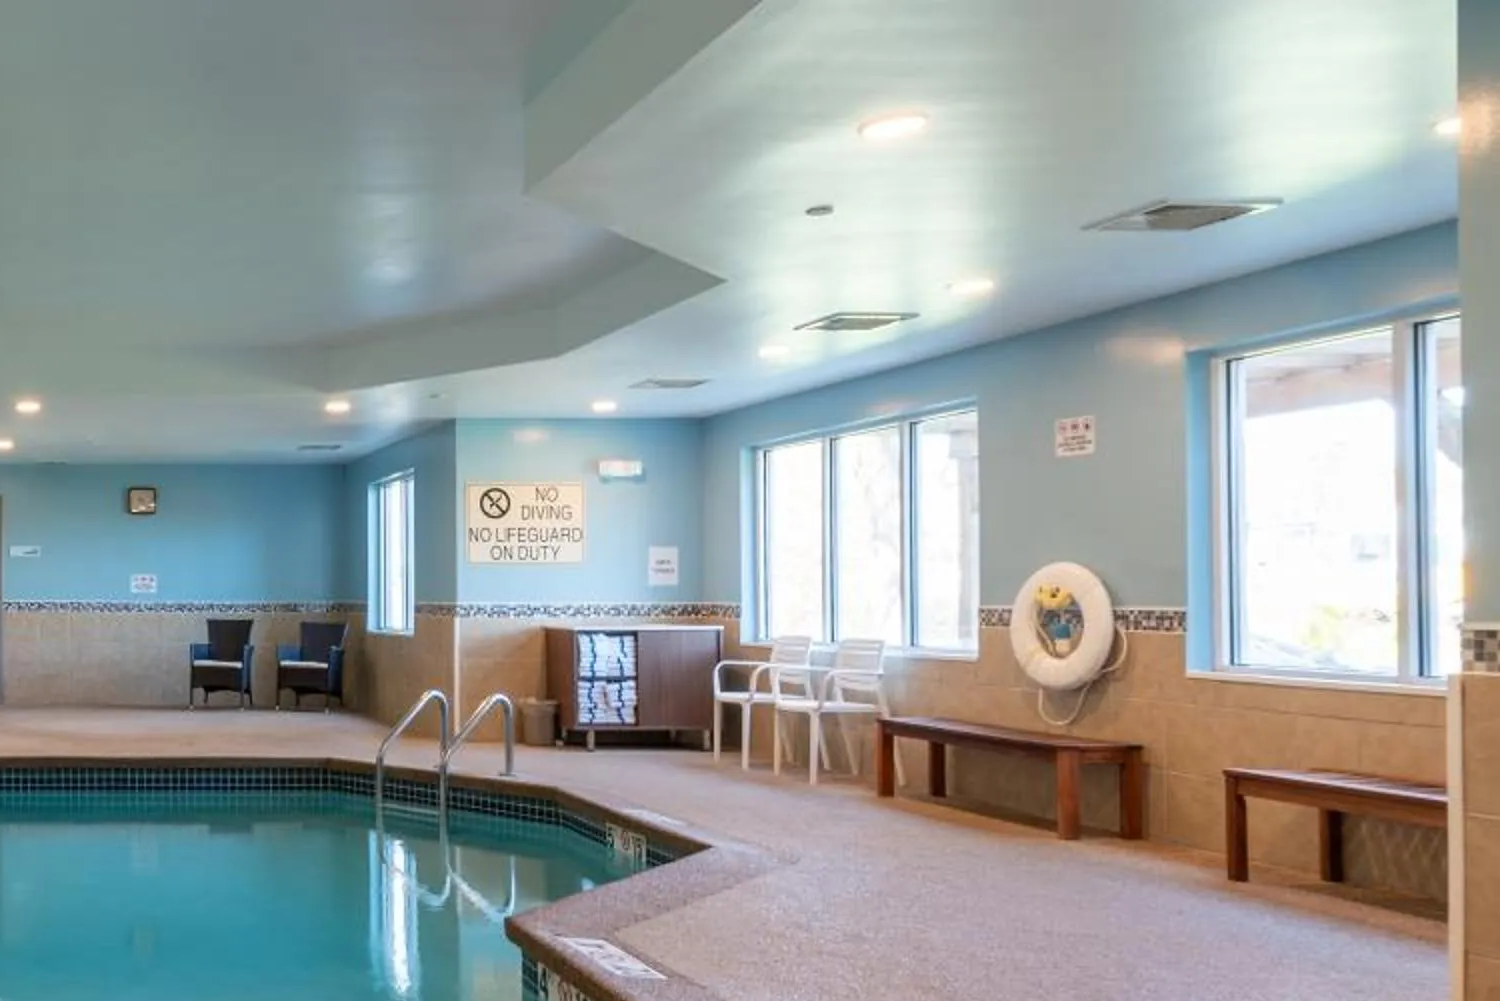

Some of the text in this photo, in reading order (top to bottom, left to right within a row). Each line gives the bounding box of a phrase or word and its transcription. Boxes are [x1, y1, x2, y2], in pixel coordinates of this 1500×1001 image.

[535, 487, 558, 503] NO
[520, 505, 573, 520] DIVING
[469, 528, 583, 543] NO LIFEGUARD
[490, 545, 561, 561] ON DUTY
